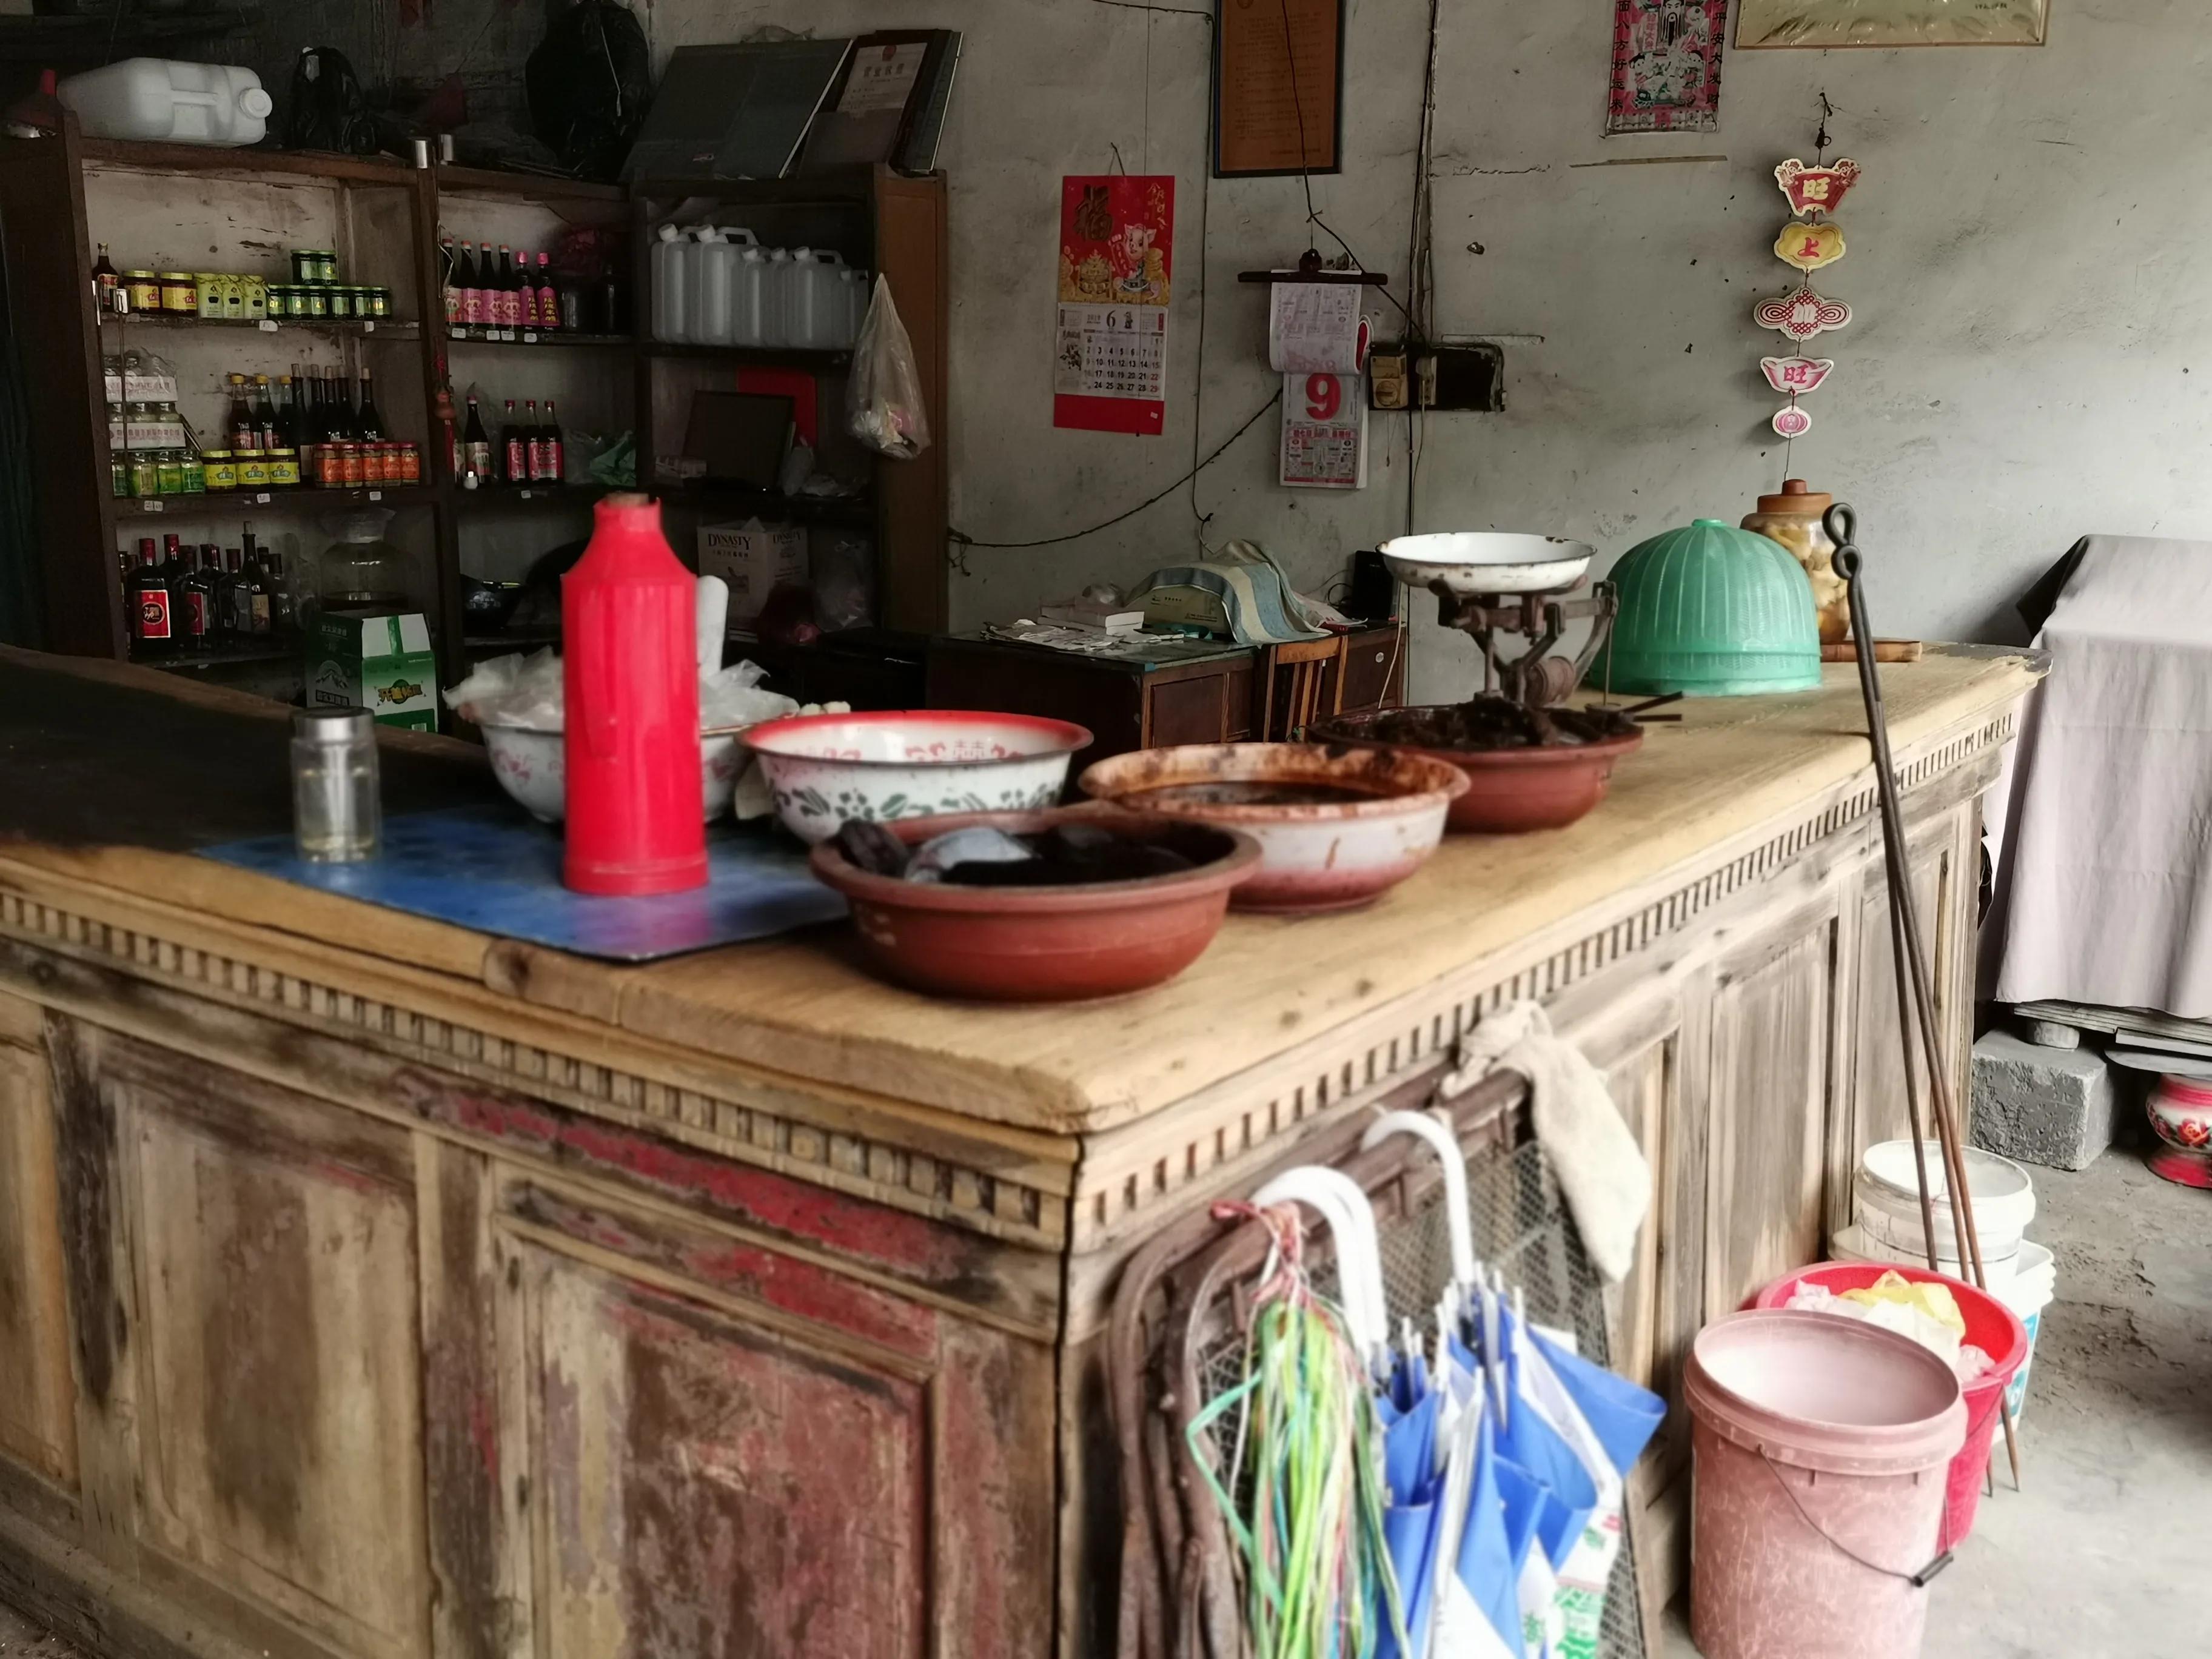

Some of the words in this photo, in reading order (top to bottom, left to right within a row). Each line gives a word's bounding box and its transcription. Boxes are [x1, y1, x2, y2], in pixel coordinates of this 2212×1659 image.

[1706, 0, 1728, 104] 平安大发财
[1803, 176, 1831, 200] 旺
[1073, 184, 1113, 242] 福
[1797, 236, 1820, 258] 上
[1106, 309, 1116, 328] 6
[1783, 364, 1809, 384] 旺
[1305, 372, 1341, 421] 9
[708, 534, 752, 551] DYNASTY
[773, 531, 801, 544] DYNASTY
